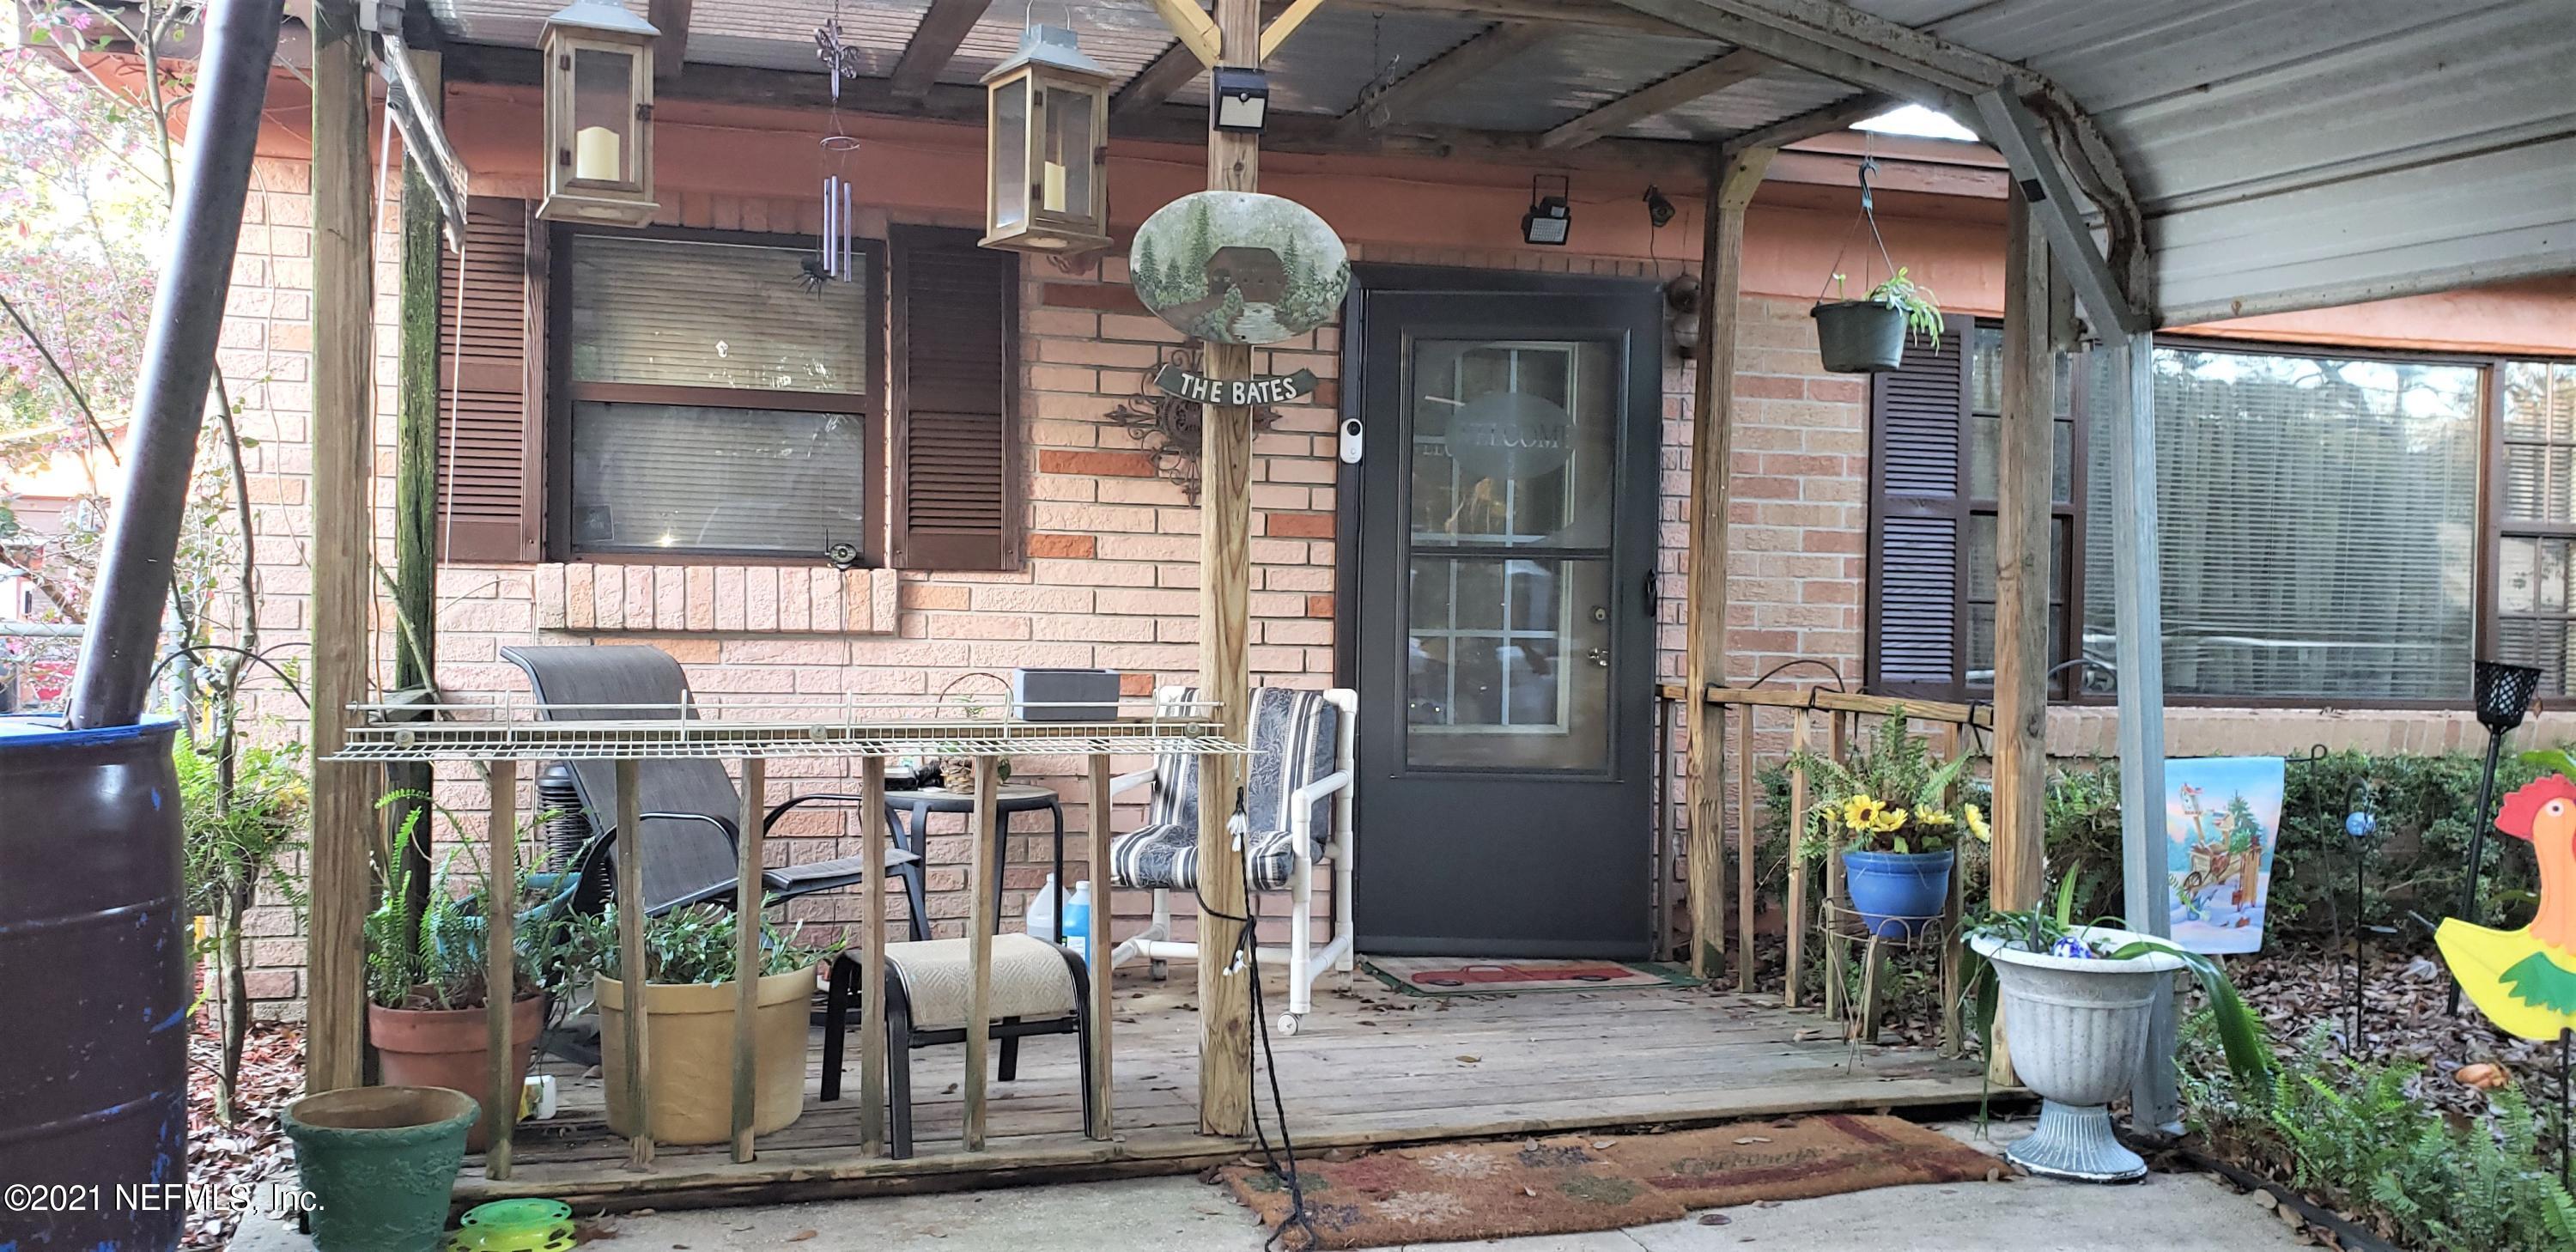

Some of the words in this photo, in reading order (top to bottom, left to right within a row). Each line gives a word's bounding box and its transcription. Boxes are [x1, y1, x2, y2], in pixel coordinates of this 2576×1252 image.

[1182, 373, 1224, 403] THE
[1232, 377, 1297, 404] BATES
[1460, 422, 1571, 448] ELCOME
